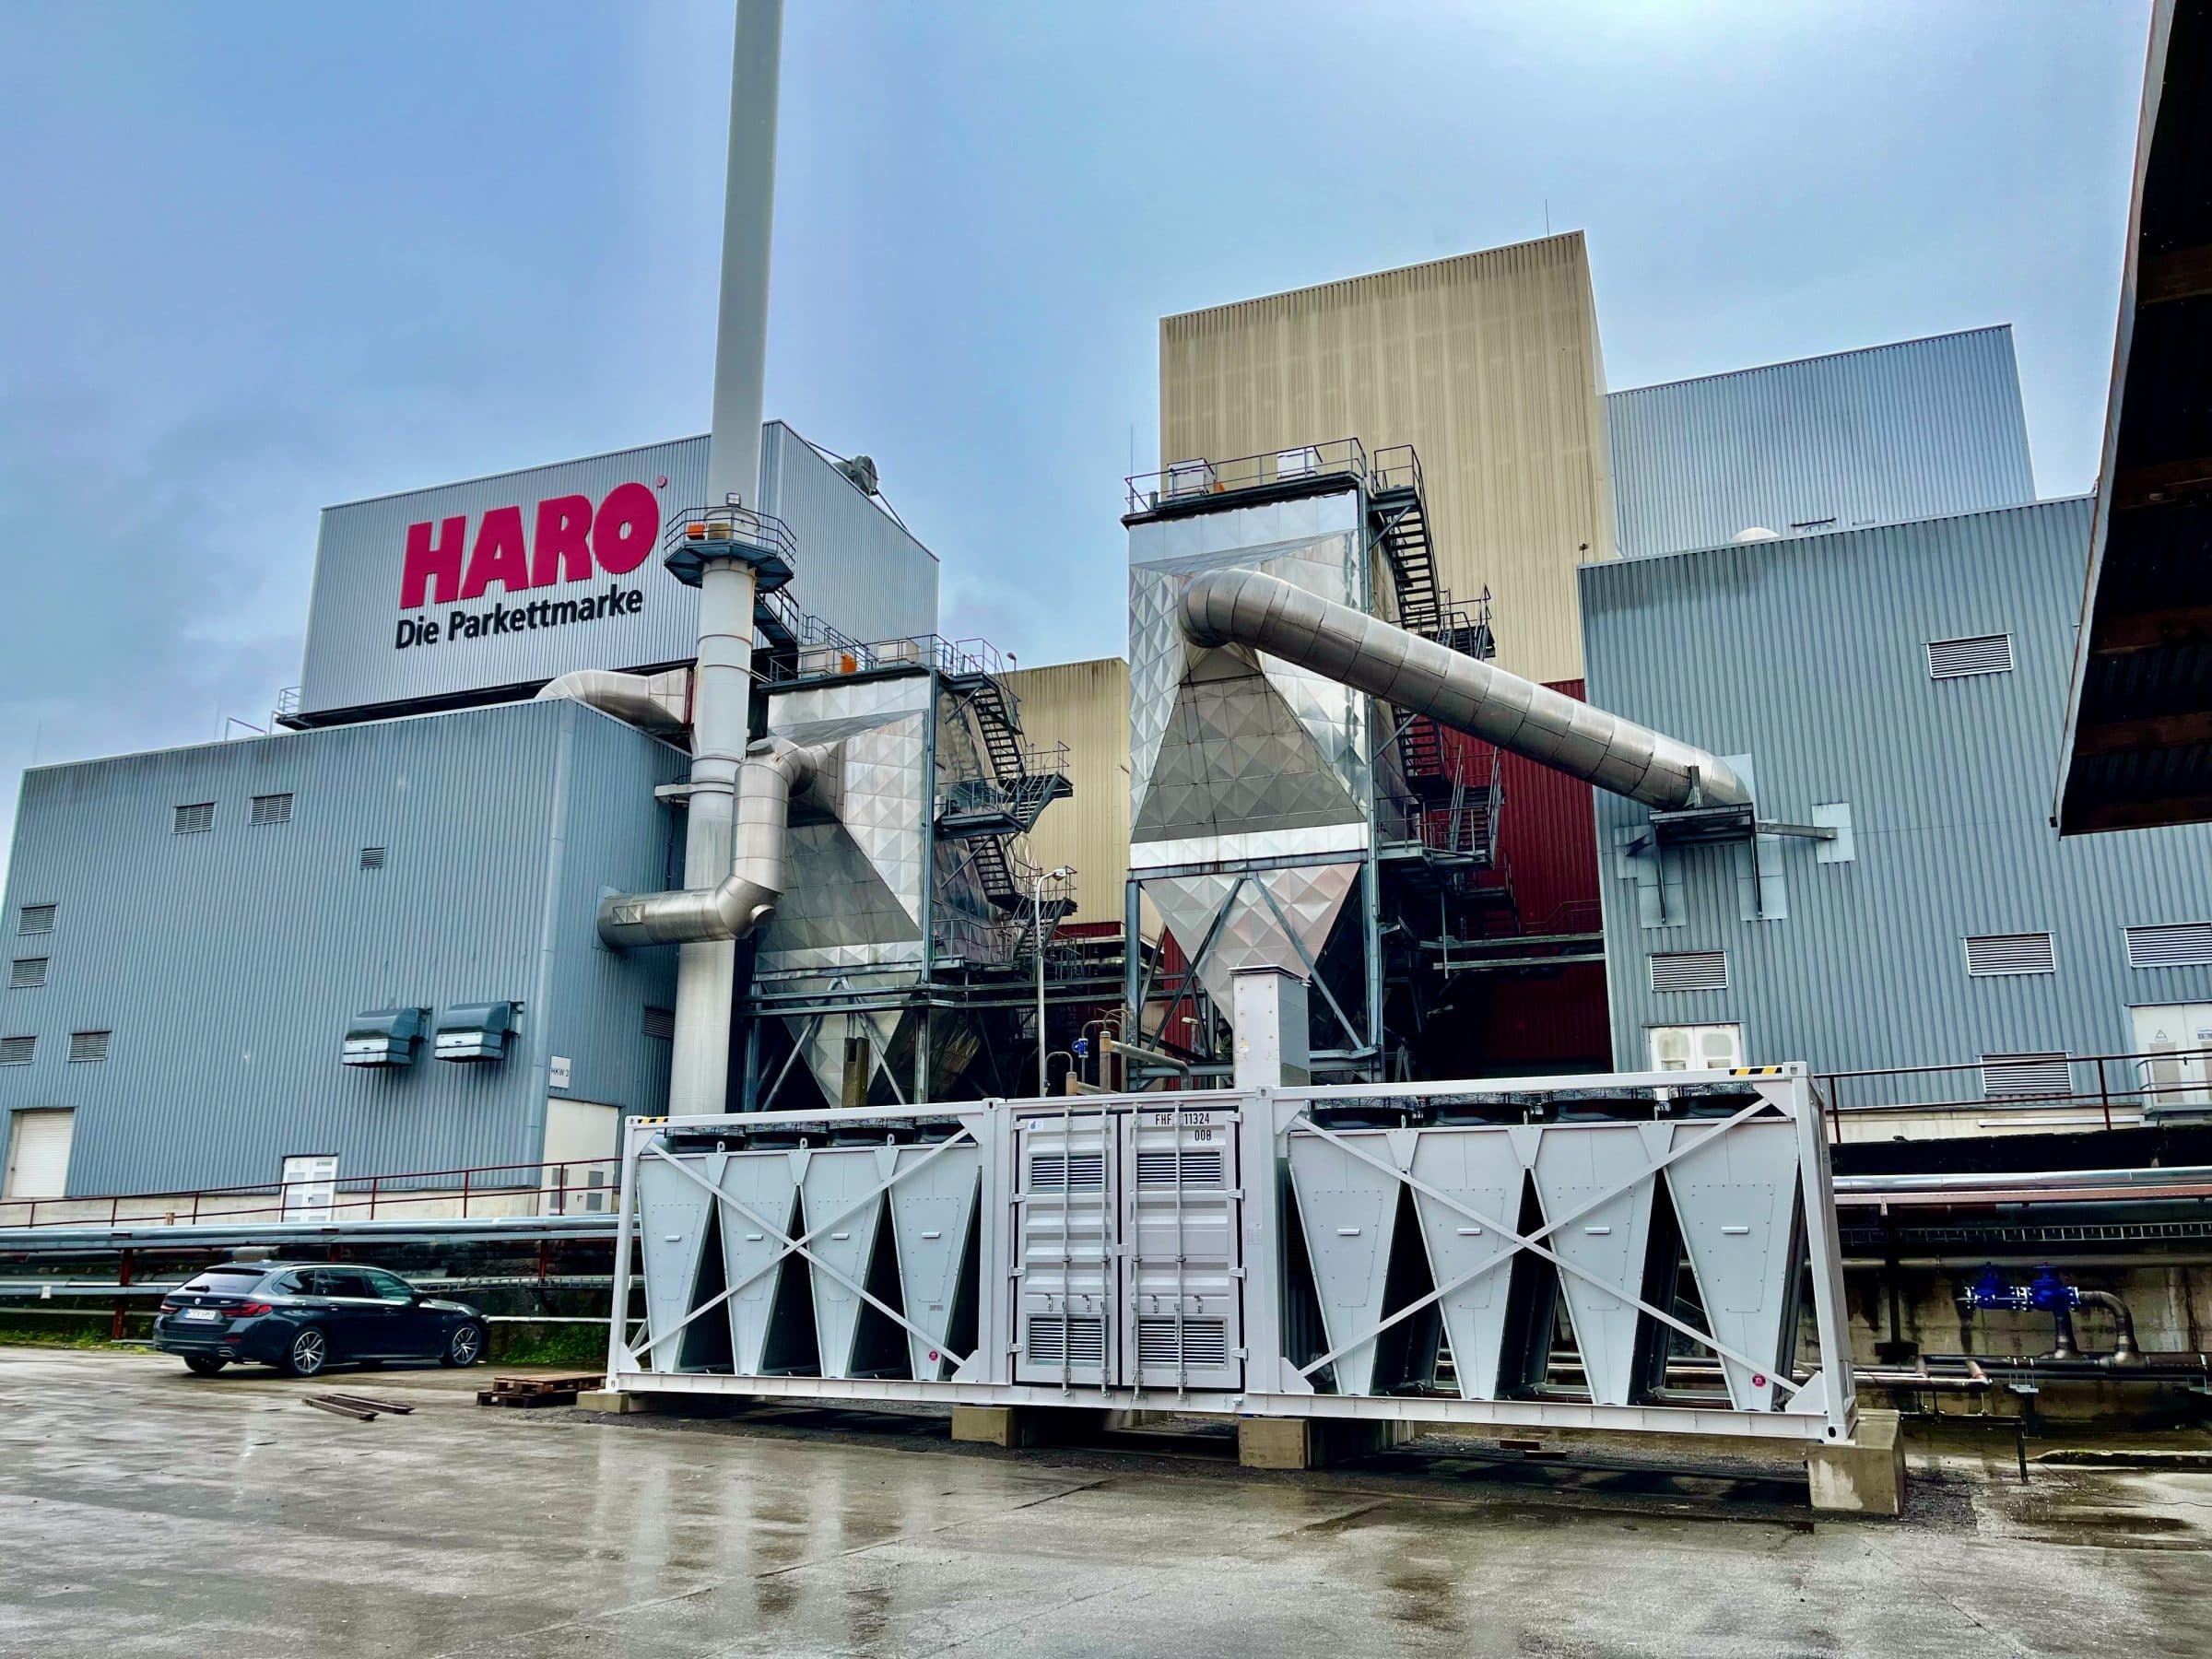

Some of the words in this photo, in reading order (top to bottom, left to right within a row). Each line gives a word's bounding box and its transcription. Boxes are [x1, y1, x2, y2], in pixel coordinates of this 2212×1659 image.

[399, 481, 660, 610] HARO
[395, 616, 440, 650] Die
[448, 583, 644, 641] Parkettmarke
[1184, 1112, 1210, 1125] 11324
[1194, 1129, 1212, 1142] 008
